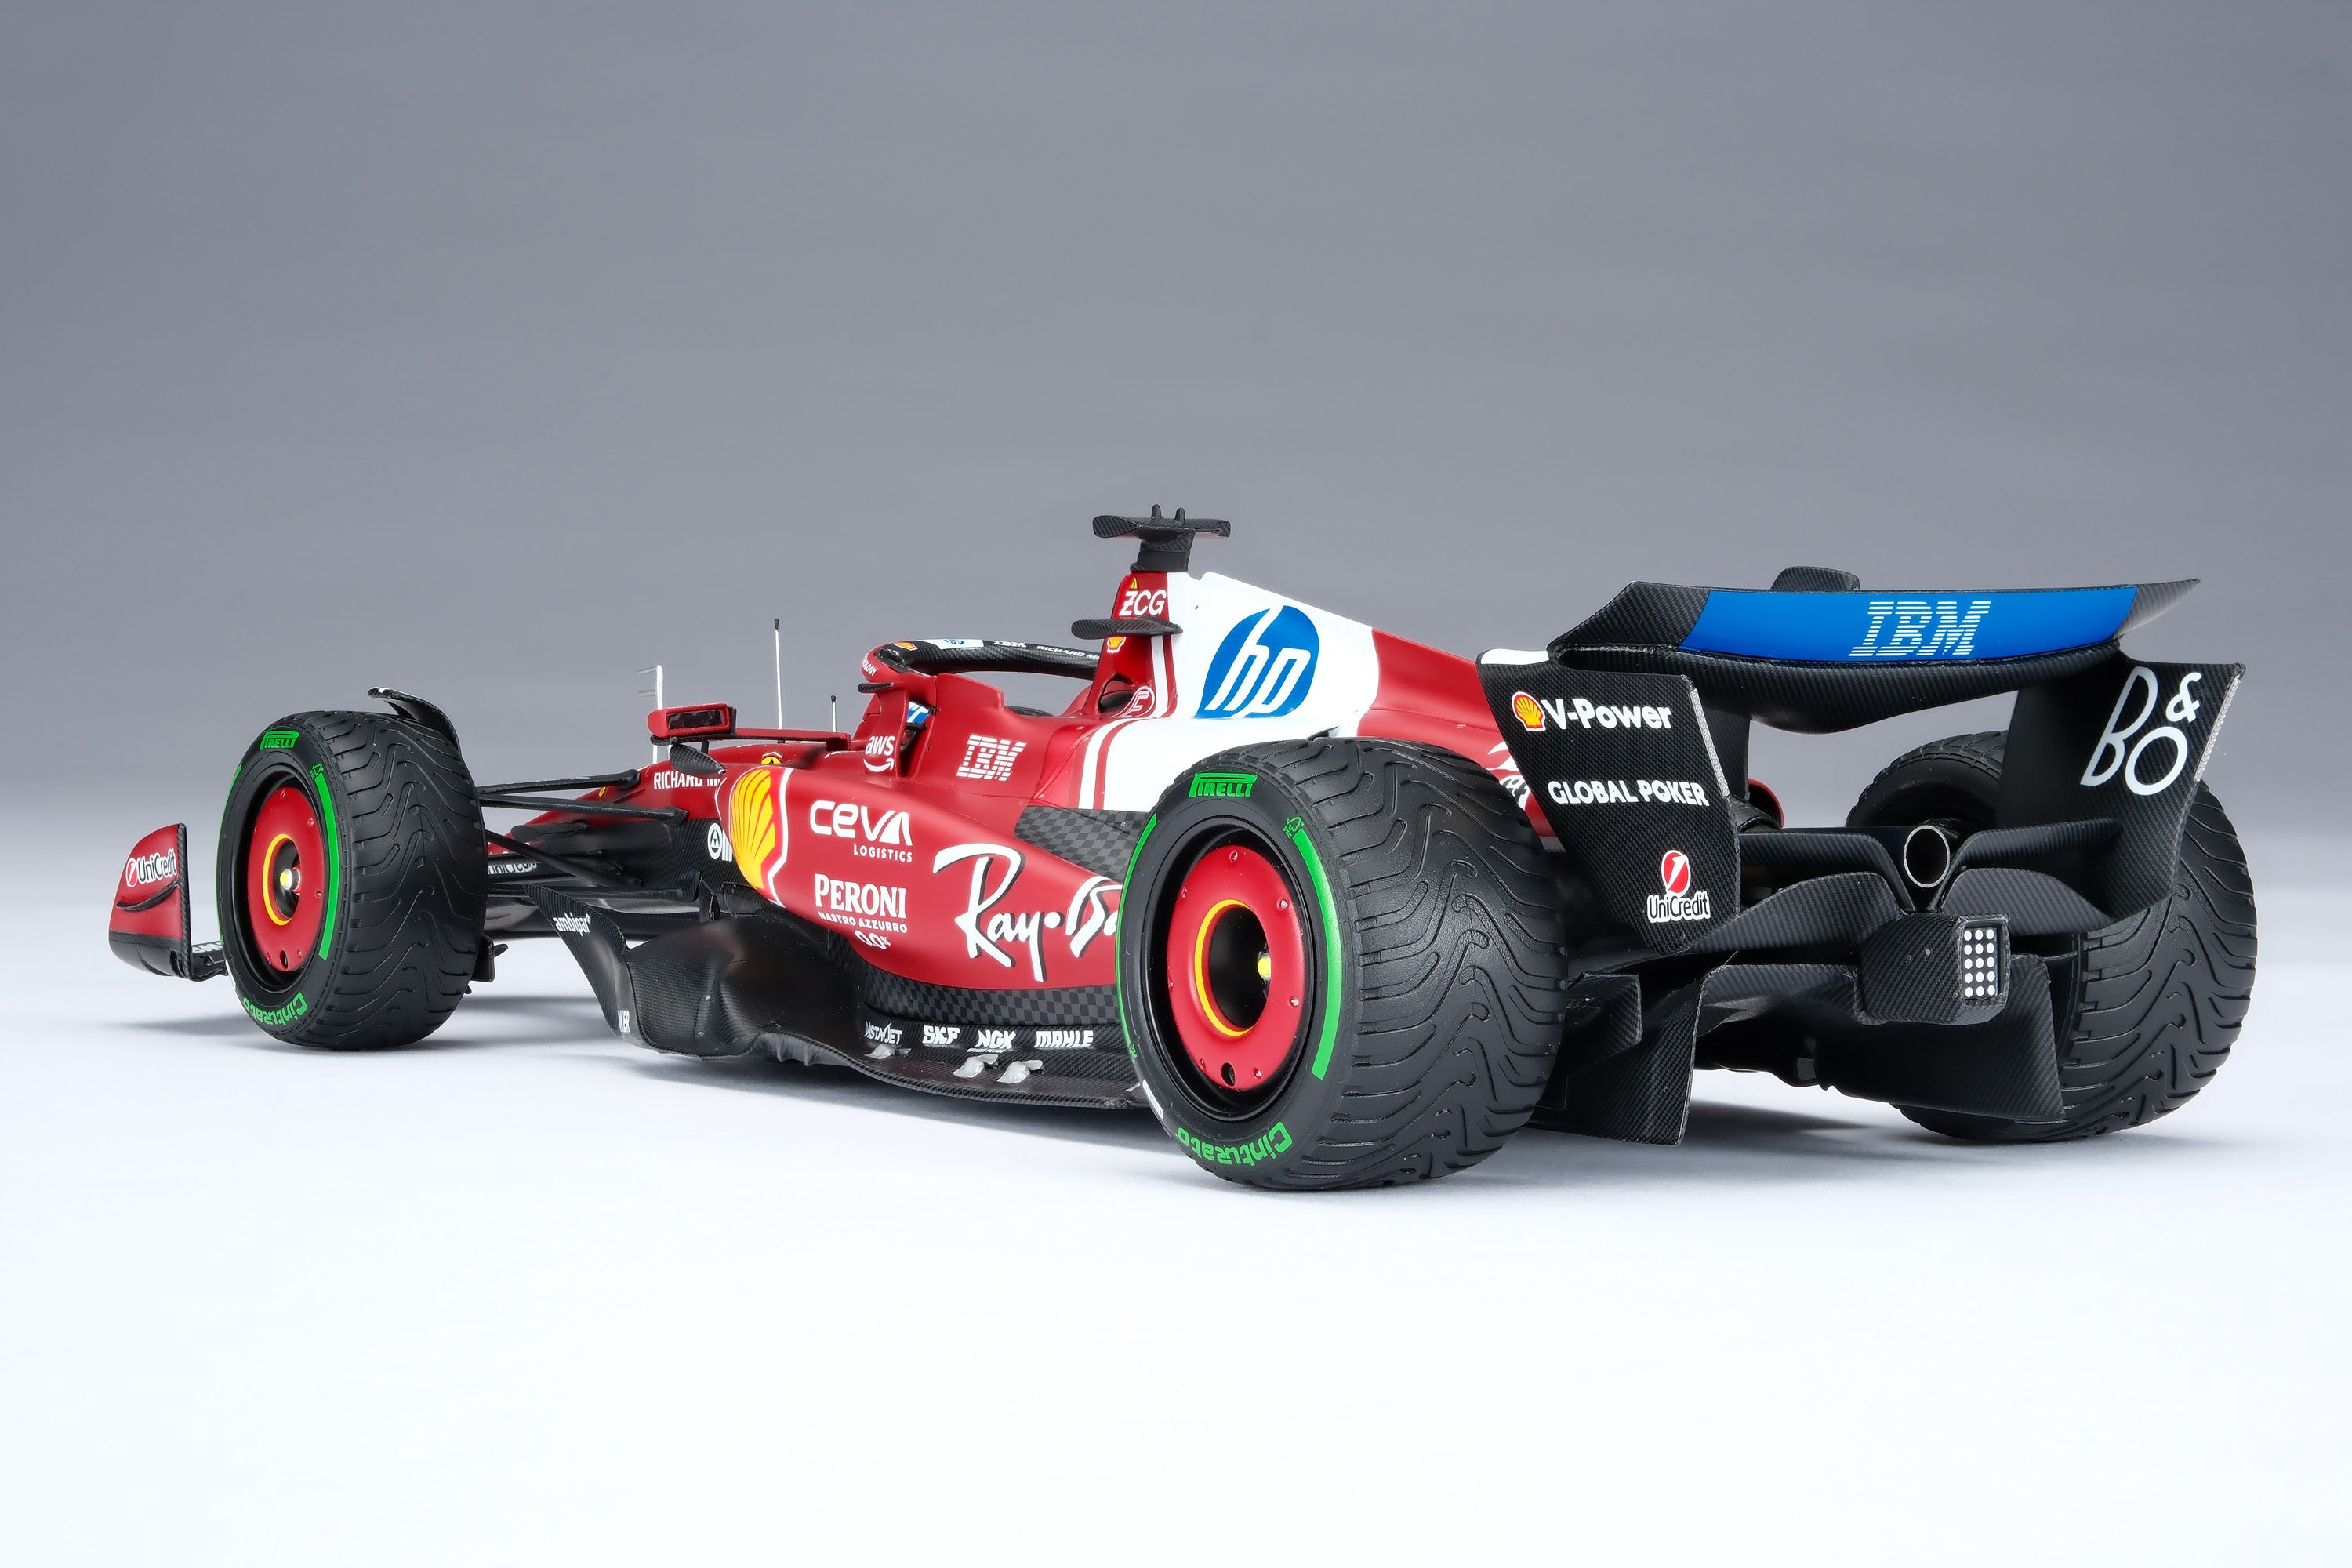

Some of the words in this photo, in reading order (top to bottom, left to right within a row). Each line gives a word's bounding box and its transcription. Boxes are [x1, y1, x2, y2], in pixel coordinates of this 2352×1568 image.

[1119, 589, 1167, 617] ZCG
[1849, 601, 1991, 655] IBM
[1036, 645, 1086, 657] RICHARD
[1203, 606, 1312, 718] hp
[1542, 699, 1672, 731] V-Power
[260, 730, 300, 750] PIRELLI
[866, 736, 895, 756] aws
[956, 734, 1026, 782] IBM
[654, 771, 703, 789] RICHARD
[1189, 772, 1258, 798] PIRELLI
[1548, 781, 1636, 804] GLOBAL
[1639, 780, 1709, 806] POKER
[137, 848, 177, 884] UniCredit
[854, 844, 913, 862] LOGISTICS
[815, 873, 907, 919] PERONI
[1648, 892, 1711, 921] UniCredit
[553, 913, 590, 937] ambipar
[818, 911, 856, 926] NASTRO
[858, 918, 908, 934] AZZURRO
[922, 1025, 960, 1044] SKF
[1033, 1030, 1094, 1048] MAHLE
